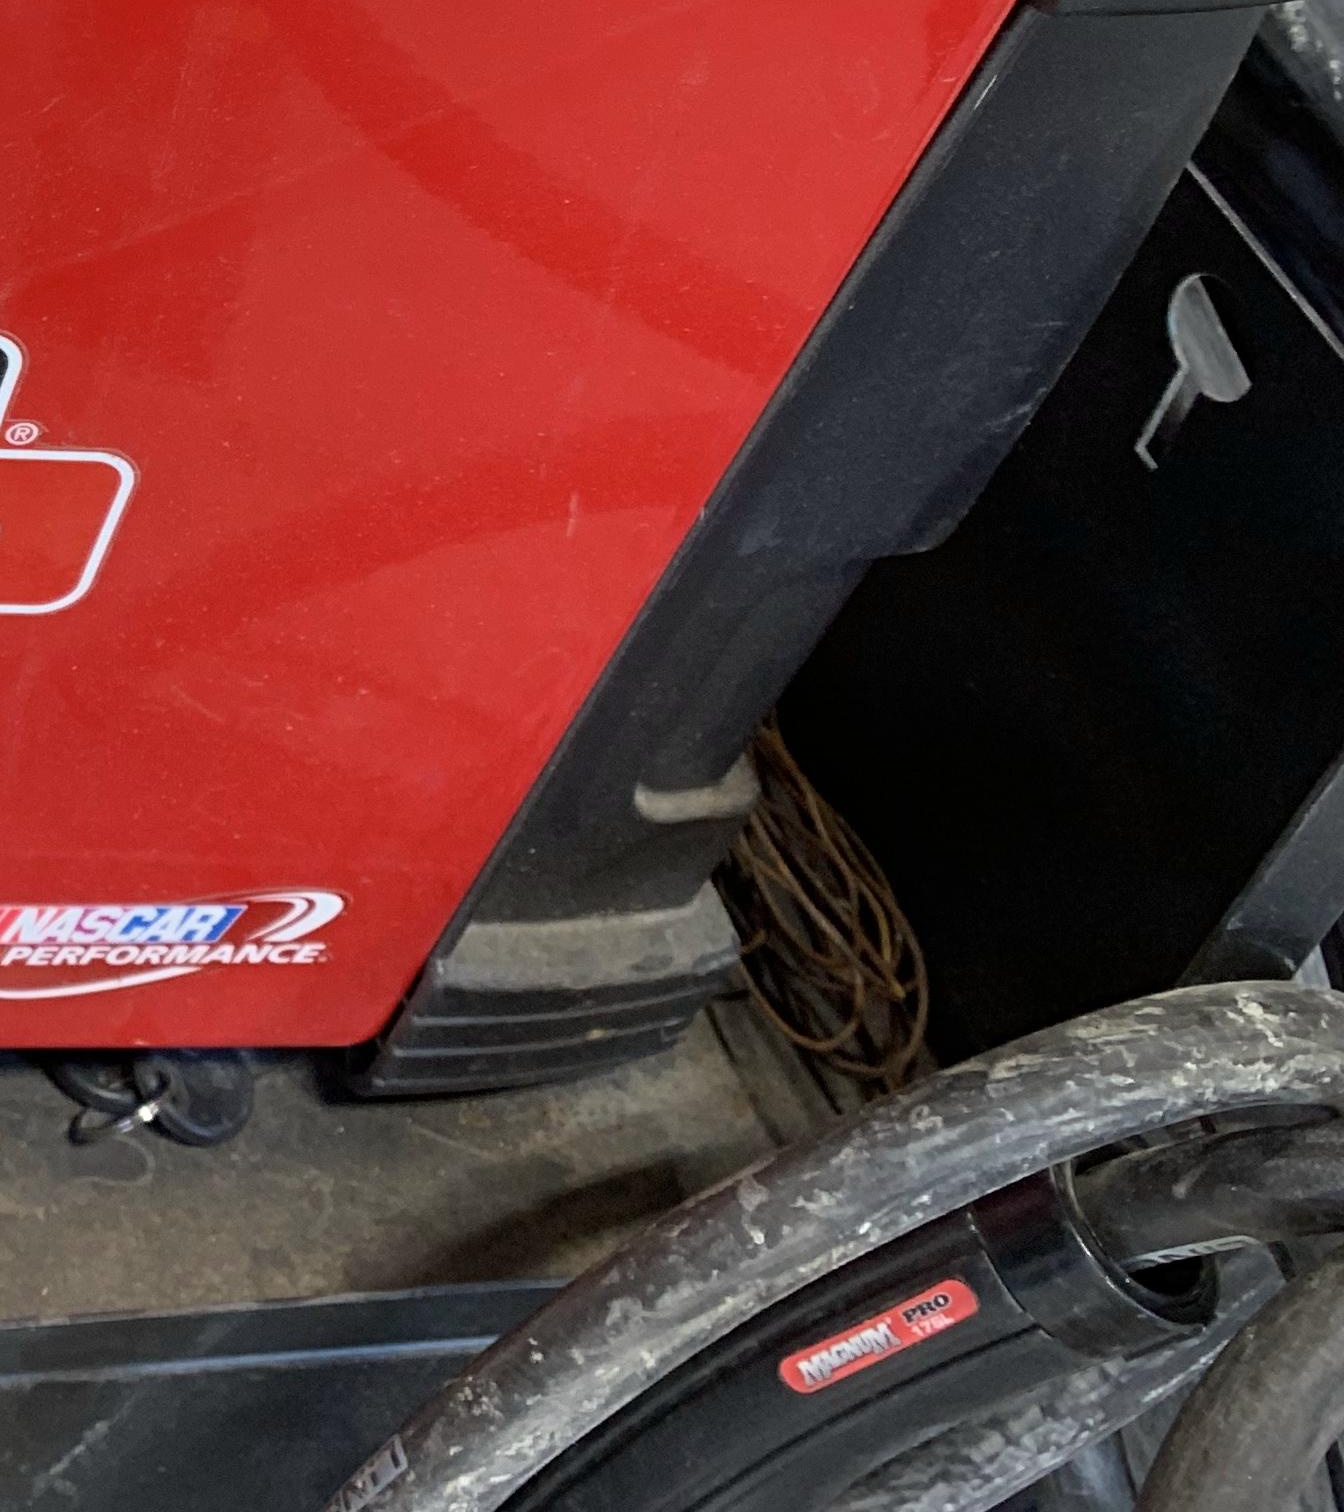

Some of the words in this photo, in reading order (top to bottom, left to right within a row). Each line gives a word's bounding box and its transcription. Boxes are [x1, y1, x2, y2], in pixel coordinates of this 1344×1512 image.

[0, 943, 326, 967] PERFORMANCE
[796, 1322, 902, 1387] MAGNUM
[900, 1294, 952, 1325] PRO
